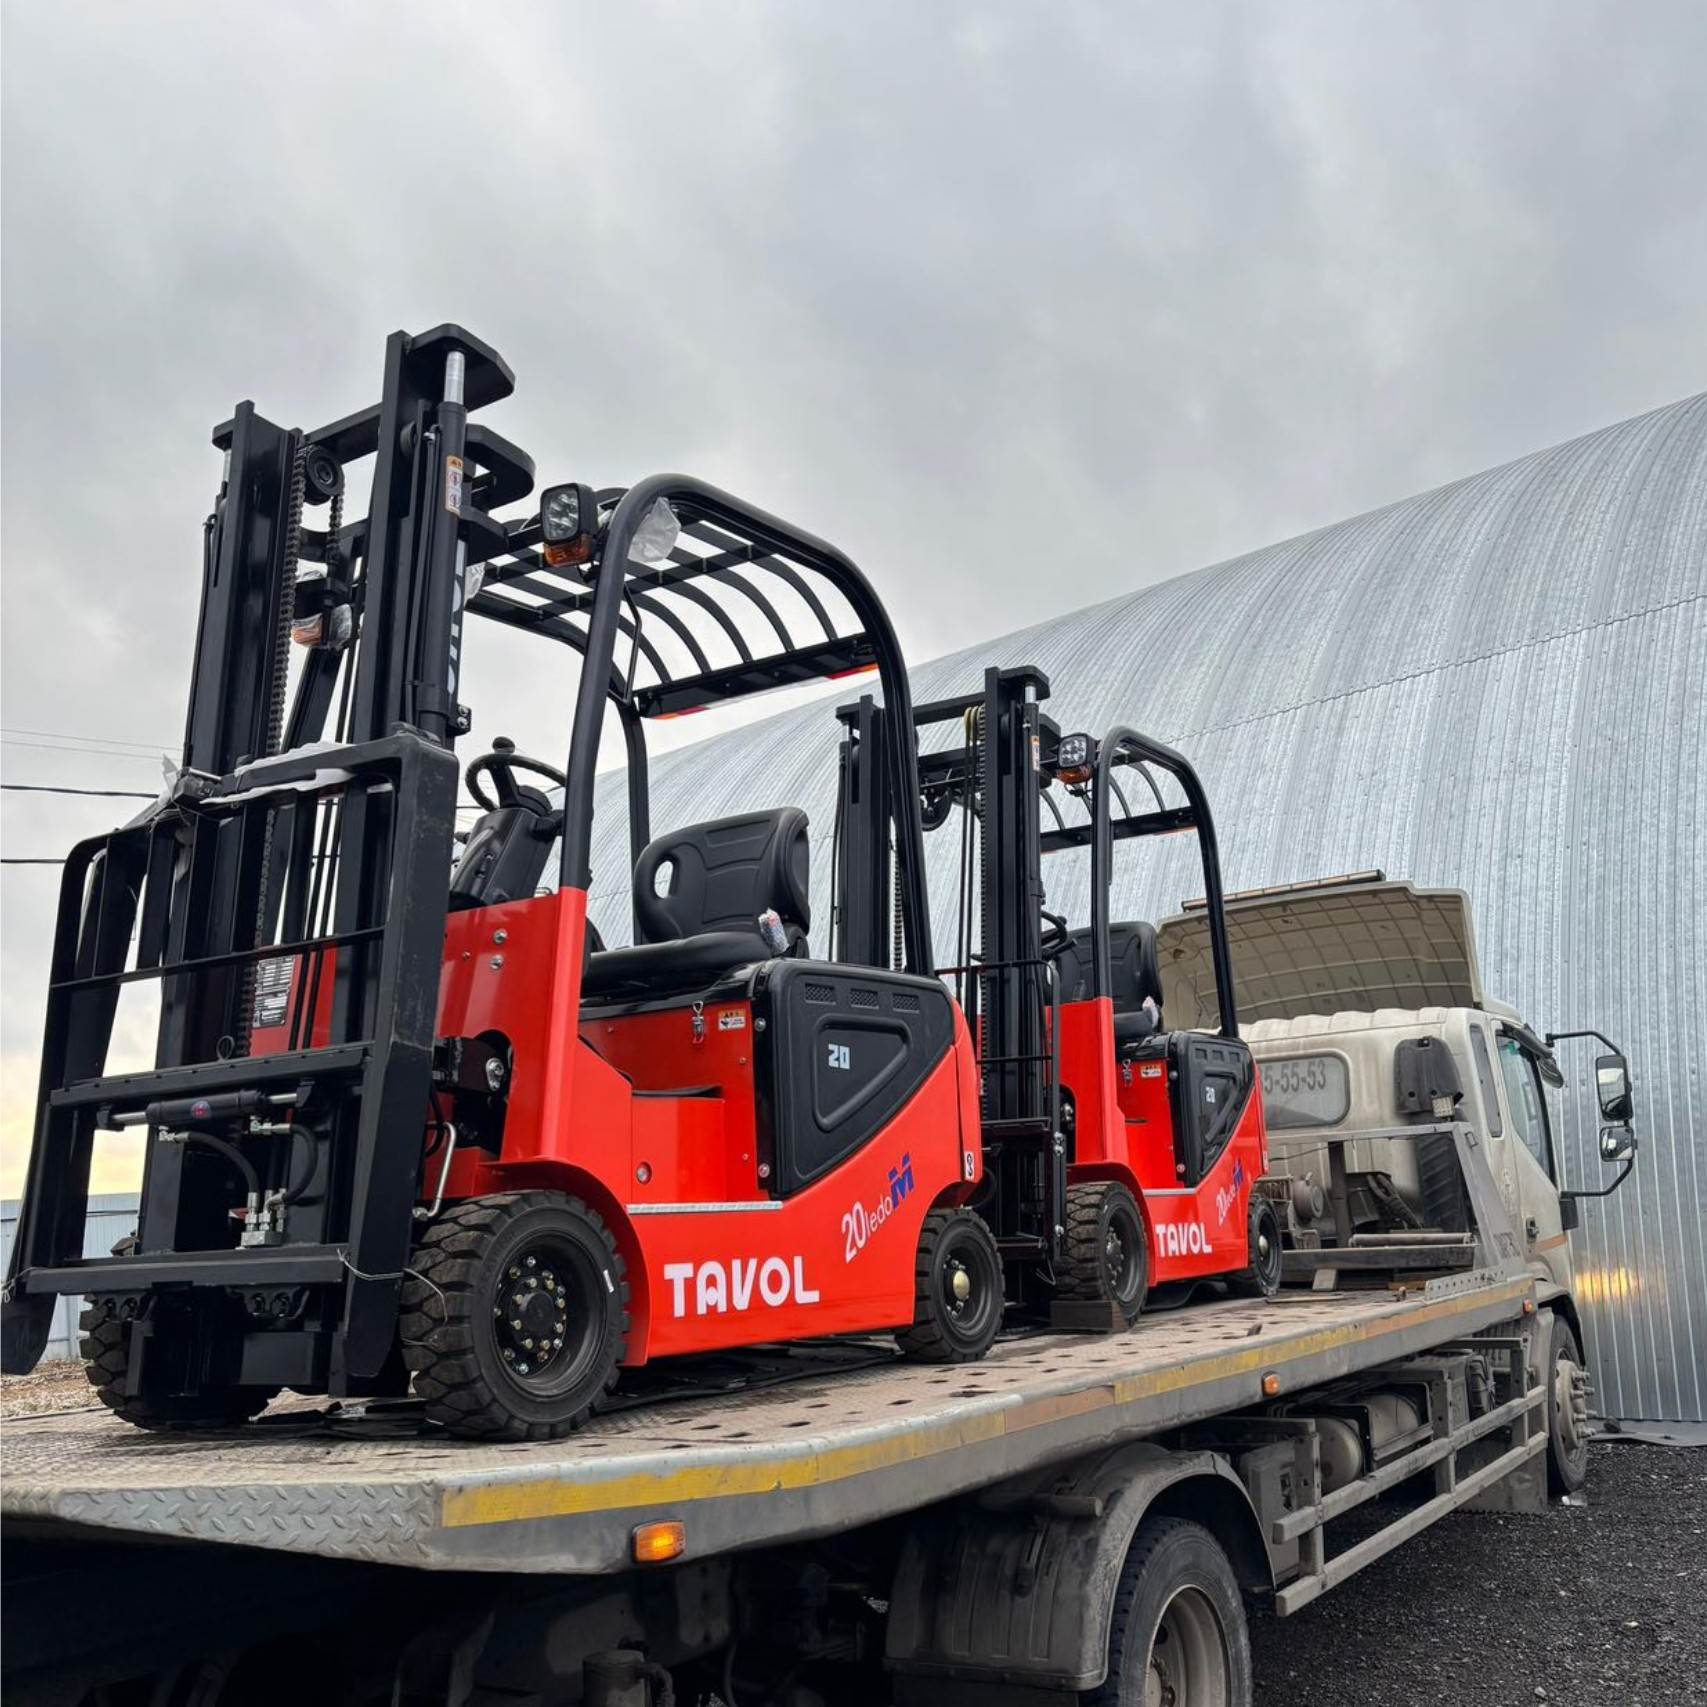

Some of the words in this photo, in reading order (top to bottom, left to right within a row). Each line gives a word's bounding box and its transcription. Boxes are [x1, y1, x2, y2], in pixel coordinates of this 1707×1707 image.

[828, 1044, 850, 1069] 20
[1154, 1222, 1213, 1257] TAVOL
[663, 1255, 820, 1318] TAVOL
